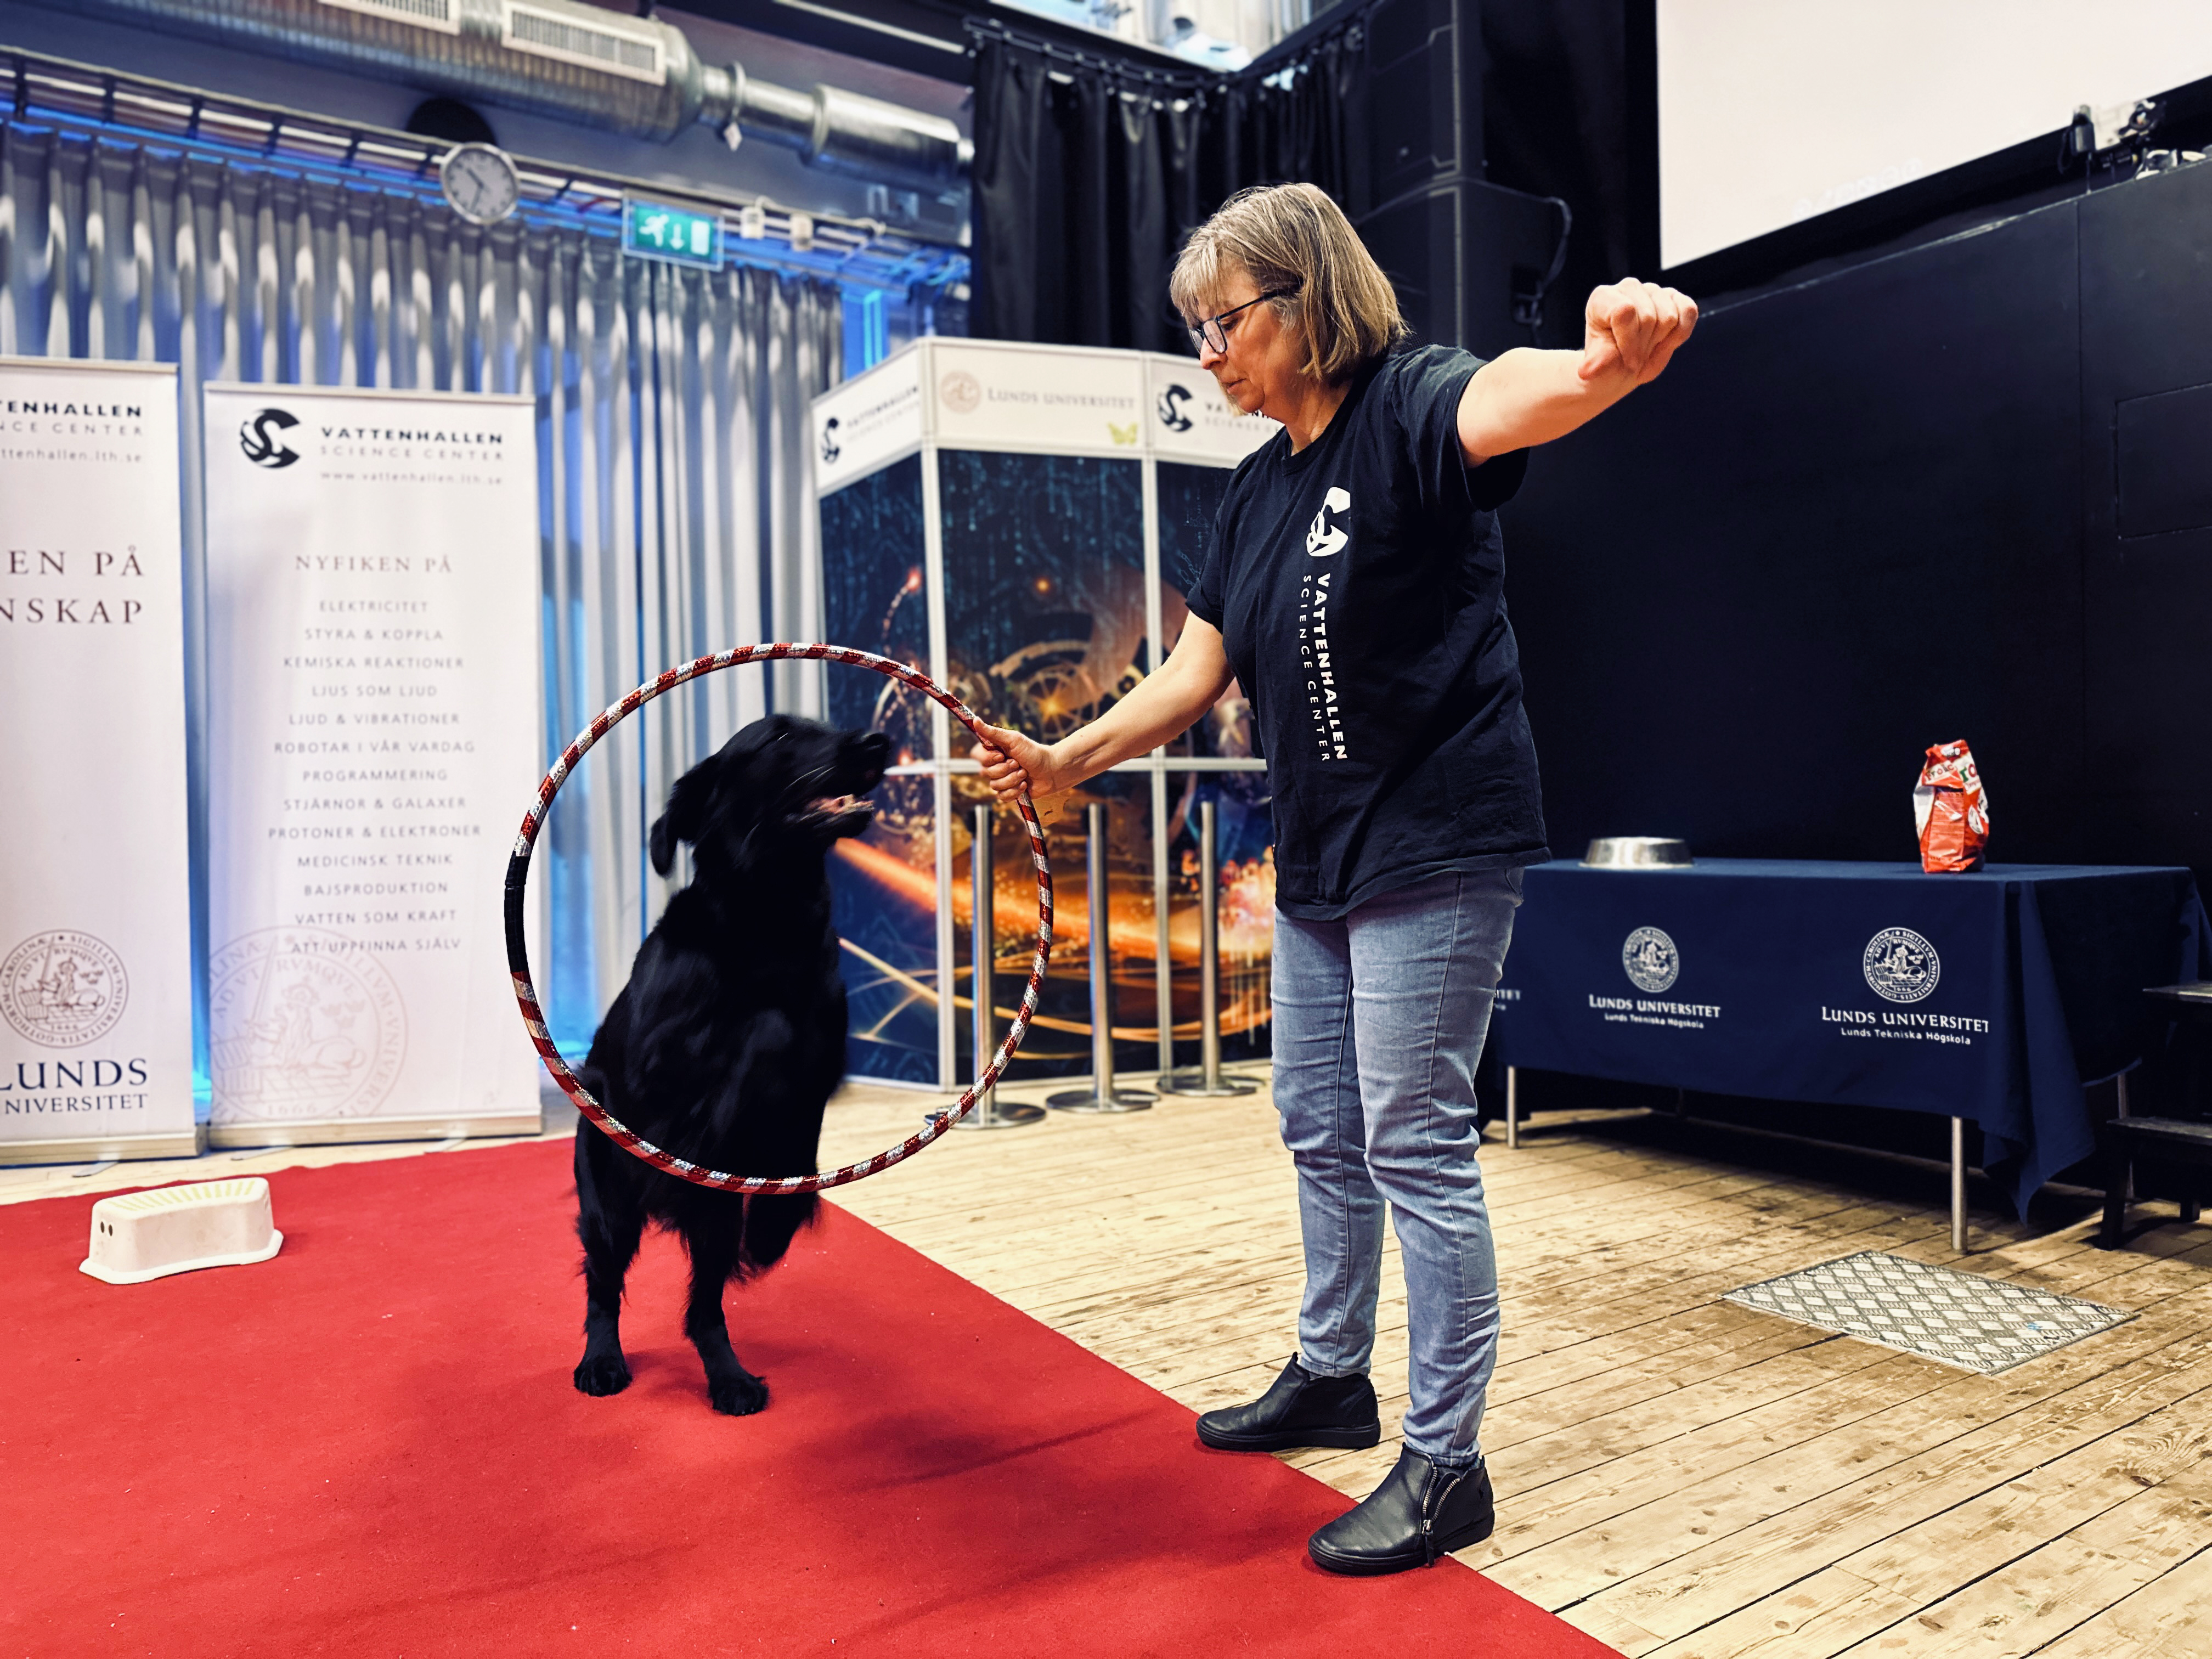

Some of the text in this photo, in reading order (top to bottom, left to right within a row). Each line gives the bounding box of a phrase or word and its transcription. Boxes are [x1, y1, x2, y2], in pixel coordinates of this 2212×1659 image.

[0, 401, 140, 417] ENHALLEN
[52, 422, 141, 436] CENTER
[322, 428, 501, 443] VATTENHALLEN
[321, 446, 502, 460] SCIENCE CENTER
[96, 546, 143, 575] PÅ
[296, 555, 451, 572] NYFIKEN PÅ
[320, 601, 427, 613] ELEKTRICITET
[306, 629, 442, 640] STYRA & KOPPLA
[284, 657, 462, 668] KEMISKA REAKTIONER
[1299, 575, 1330, 761] SCIENCE CENTER
[1313, 573, 1347, 760] VATTENHALLEN
[312, 685, 437, 697] LJUS SOM LJUD
[289, 713, 458, 725] LJUD & VIBRATIONER
[275, 740, 474, 753] ROBOTAR I VÅR VARDAG
[303, 770, 447, 781] PROGRAMMERING
[284, 798, 465, 810] STJÄRNOR & GALAXER
[269, 826, 479, 839] PROTONER & ELEKTRONER
[298, 855, 453, 867] MEDICINSK TEKNIK
[304, 882, 447, 896] BAJSPRODUKTION
[296, 910, 455, 924] VATTEN SOM KRAFT
[291, 938, 460, 953] ATT UPPFINNA SJÄLV
[1589, 994, 1720, 1018] LUNDS UNIVERSITET
[1605, 1013, 1703, 1029] Lunds Tekniska Högskola
[1822, 1007, 1989, 1033] LUNDS UNIVERSITET
[1841, 1028, 1971, 1045] Lunds Tekniska Högskola
